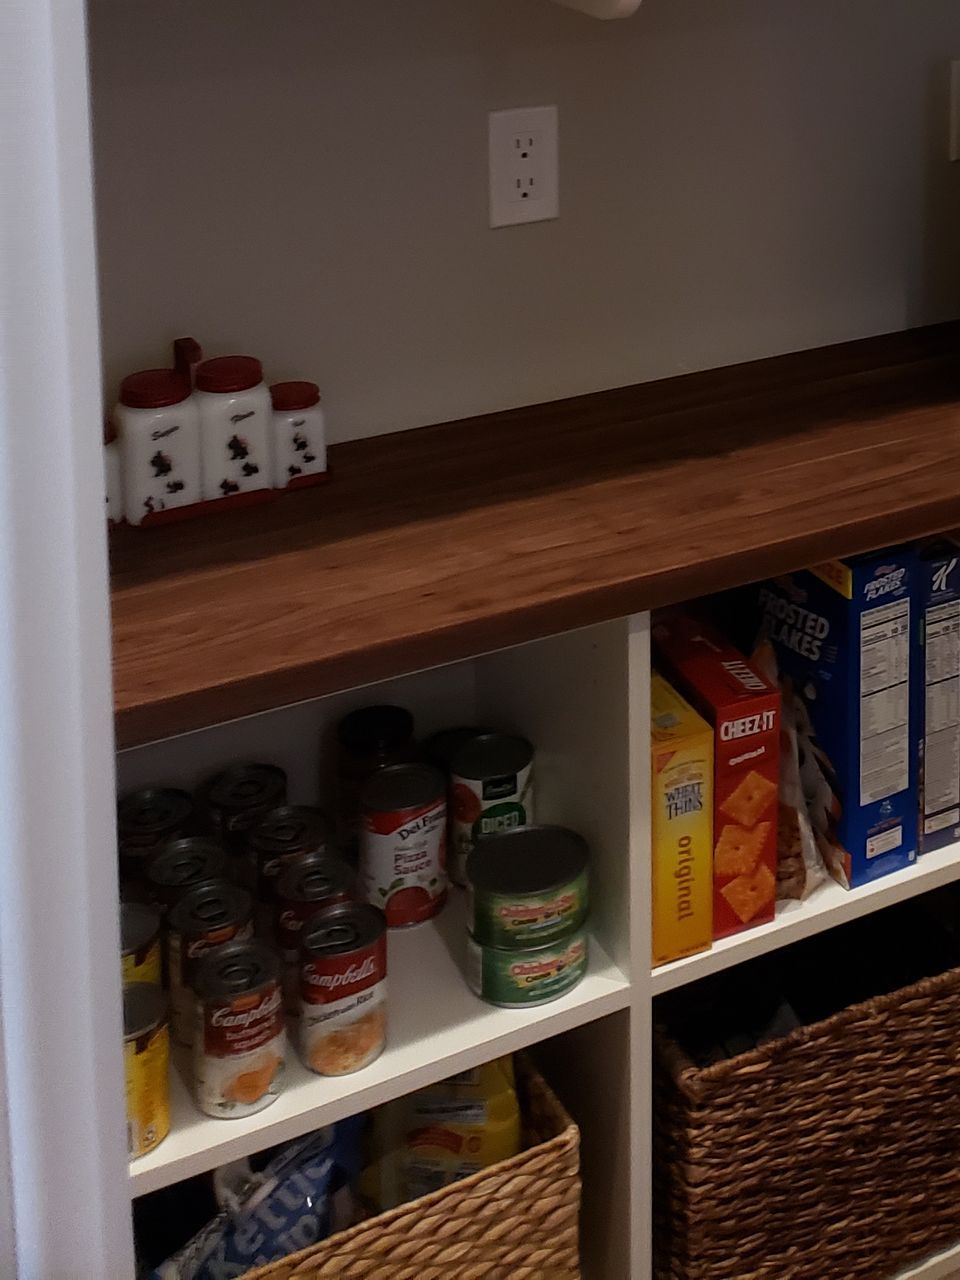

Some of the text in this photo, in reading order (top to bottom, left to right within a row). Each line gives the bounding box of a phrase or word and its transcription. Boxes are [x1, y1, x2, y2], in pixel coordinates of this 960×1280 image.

[768, 618, 824, 662] LAKES
[720, 708, 777, 742] CHEEZ-IT
[665, 781, 703, 802] WHEAT
[666, 797, 703, 821] THINS
[394, 850, 427, 864] Pizza
[394, 859, 431, 876] Sauce
[674, 835, 696, 921] original
